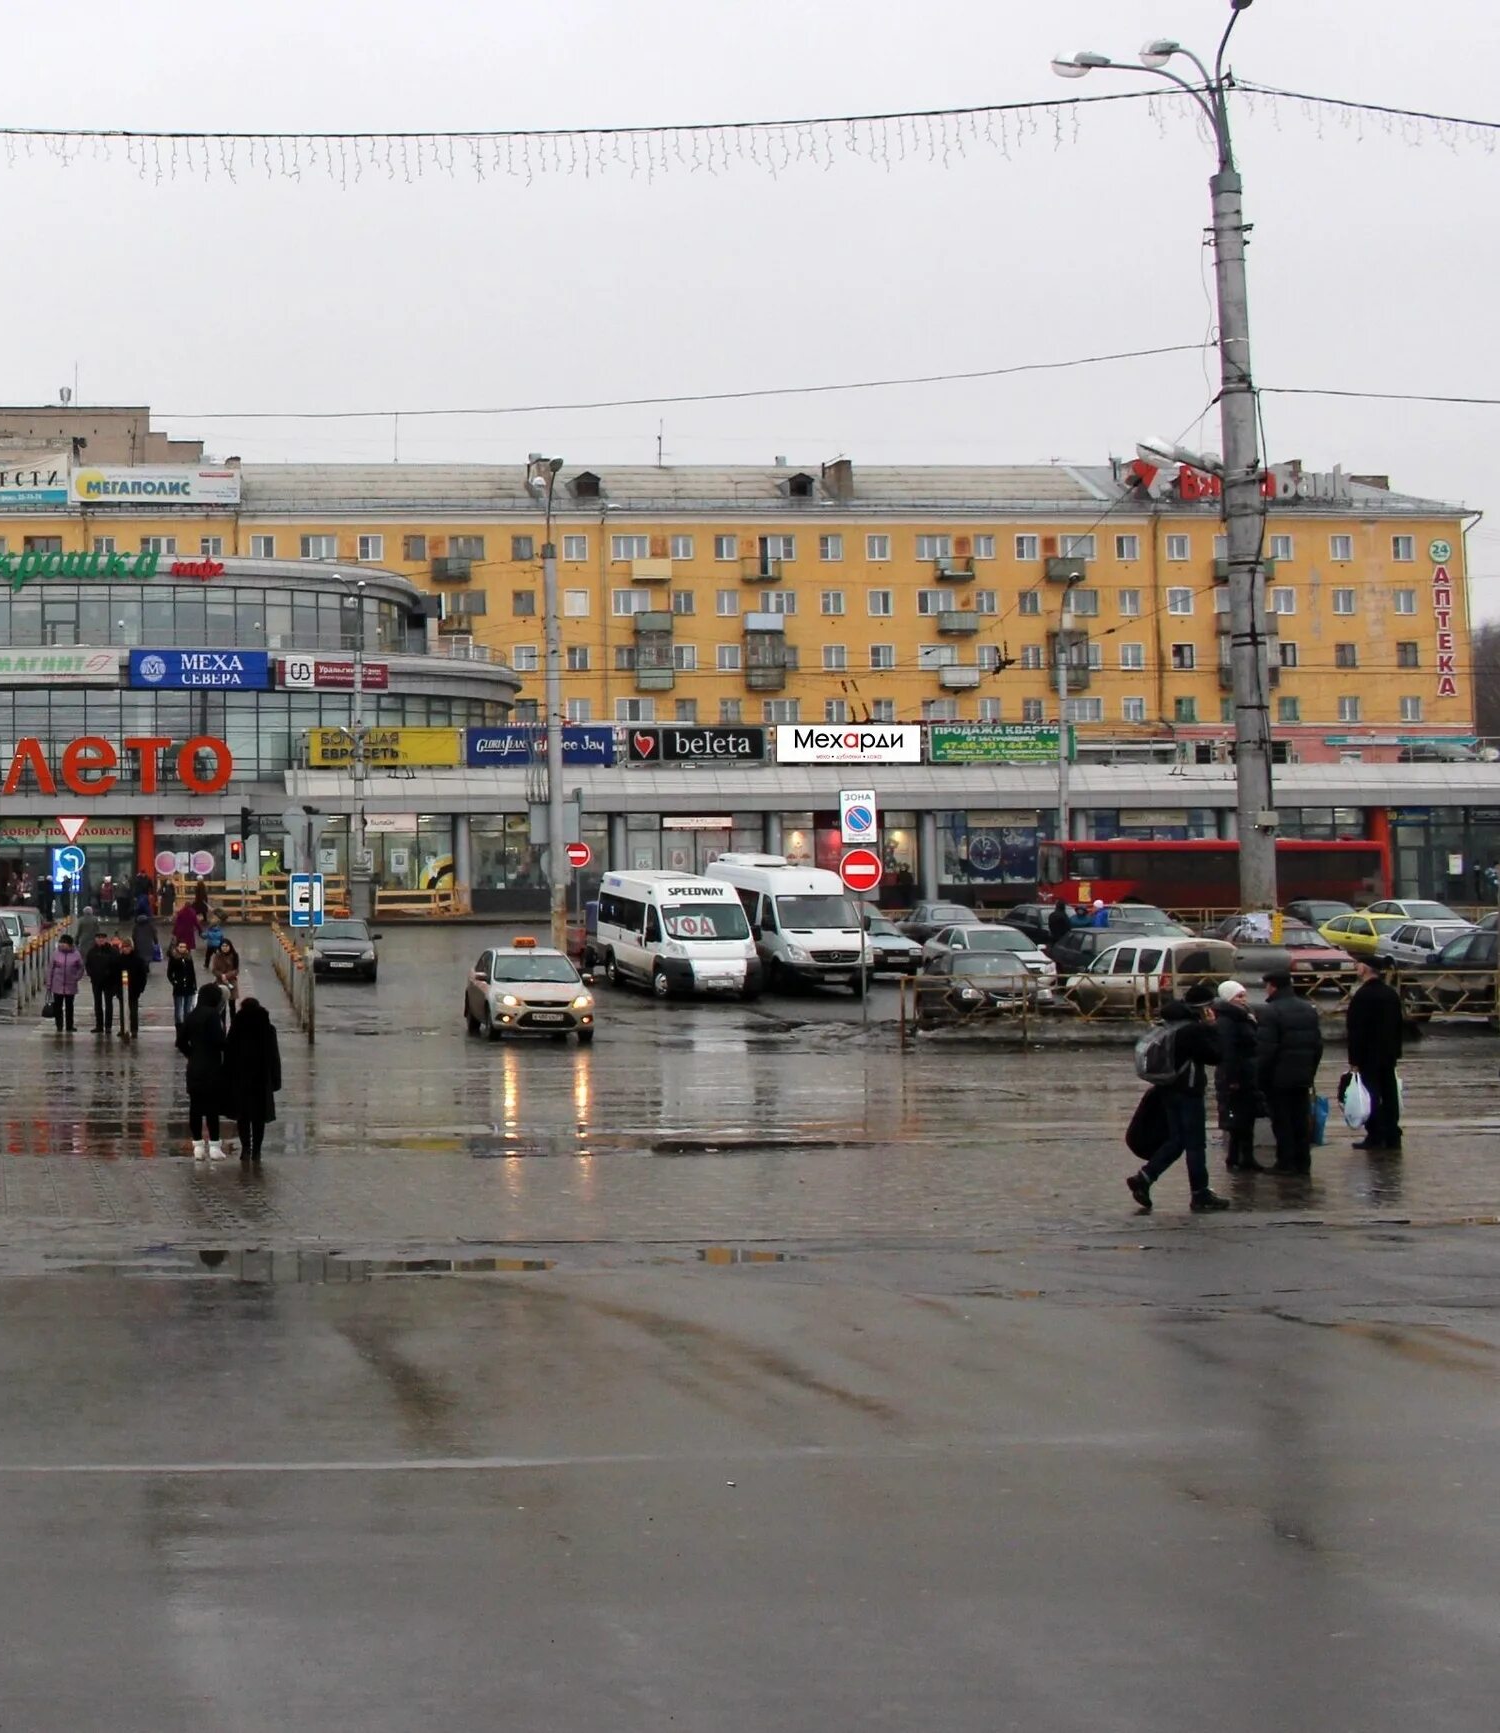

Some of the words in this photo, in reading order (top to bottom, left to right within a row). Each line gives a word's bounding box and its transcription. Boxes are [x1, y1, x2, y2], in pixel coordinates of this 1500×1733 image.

[86, 481, 191, 496] МЕГАПОЛИС
[1432, 544, 1449, 554] 24
[1433, 565, 1457, 697] АПТЕКА
[181, 654, 243, 671] МЕХА
[182, 673, 241, 684] СЕВЕРА
[934, 726, 1001, 736] ПРОДАЖА
[1005, 726, 1059, 735] КВАРТИ
[320, 732, 399, 745] БОЛШАЯ
[794, 729, 903, 752] Мехарди
[844, 793, 871, 801] ЗОНА
[46, 827, 131, 836] ПОЛОВАТЬ!
[668, 887, 724, 896] SPEEDWAY
[666, 915, 714, 936] УФА
